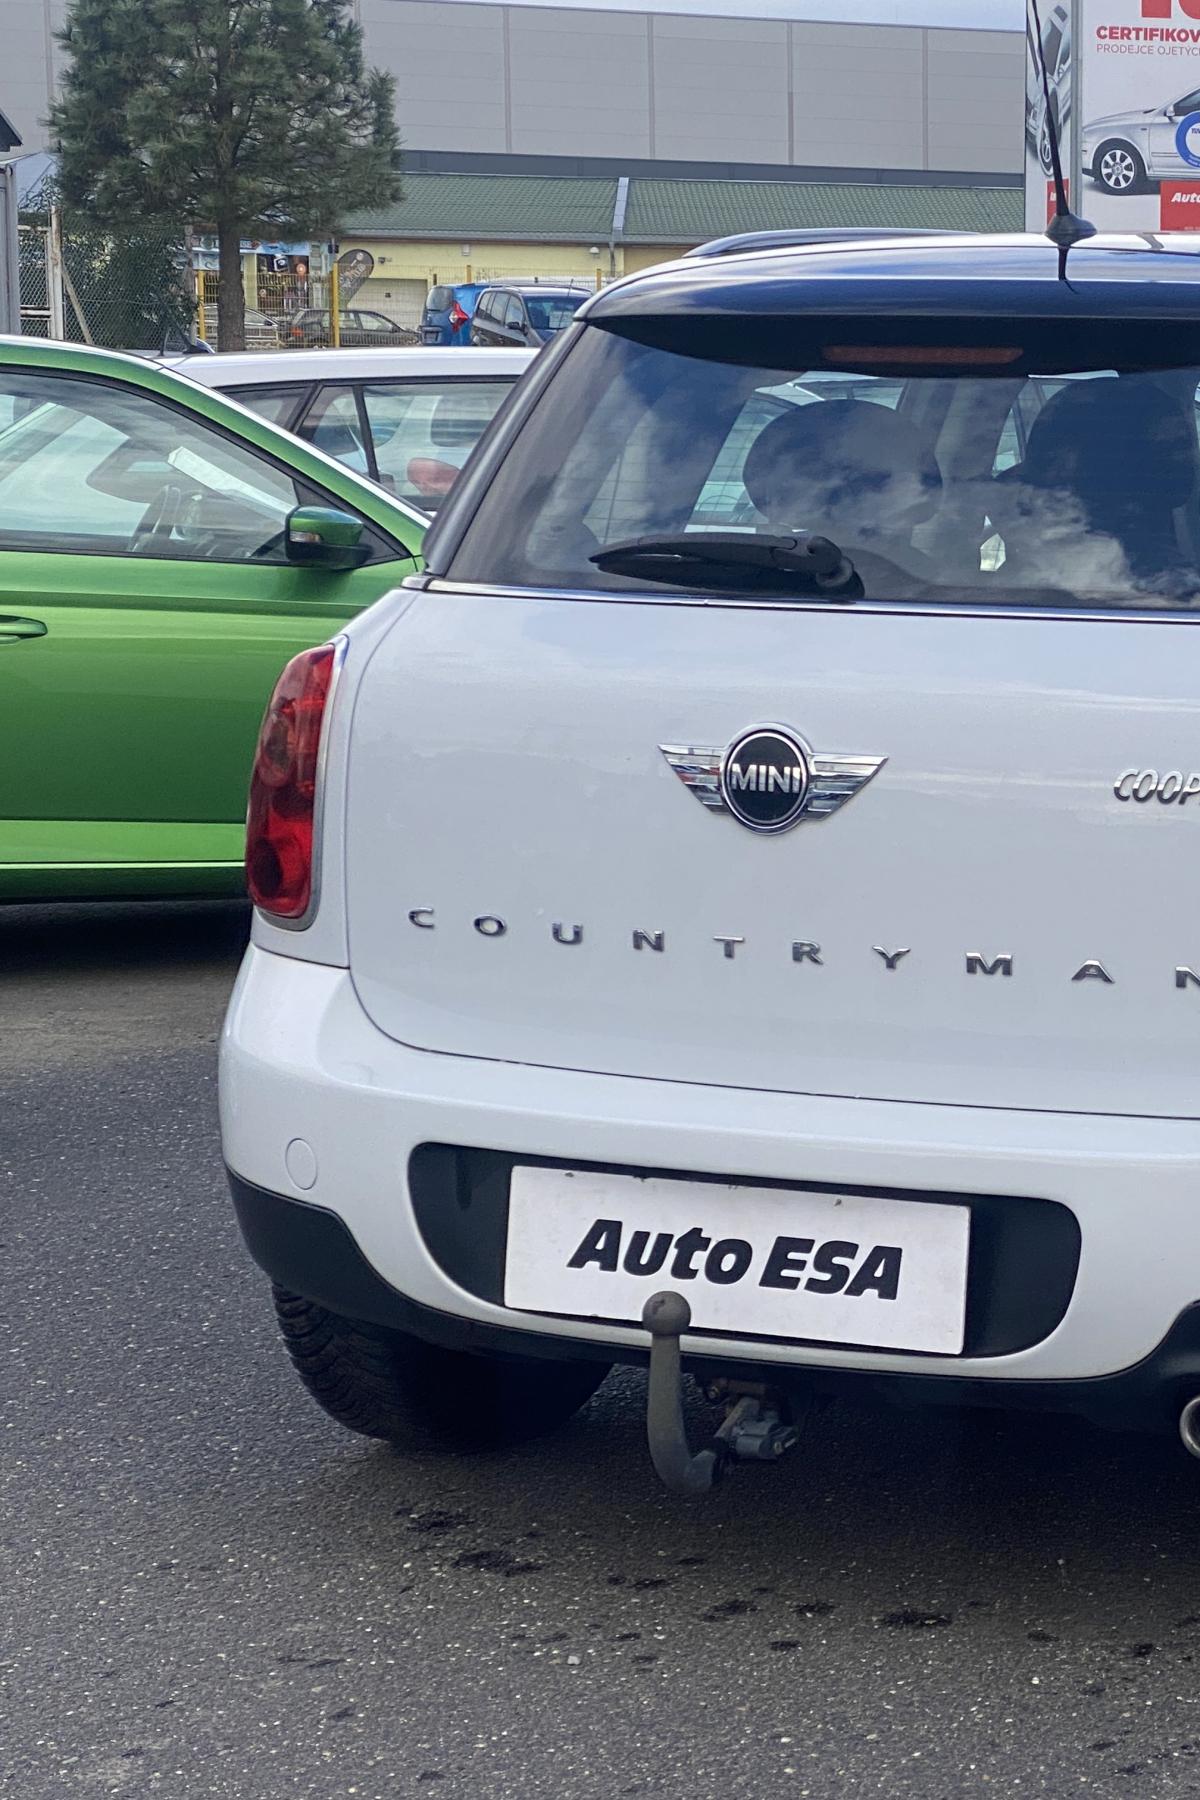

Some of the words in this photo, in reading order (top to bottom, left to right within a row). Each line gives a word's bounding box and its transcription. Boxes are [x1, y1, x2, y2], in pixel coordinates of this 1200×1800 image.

[1096, 43, 1154, 55] PRODEJCE
[730, 764, 803, 793] MINI
[566, 1218, 753, 1286] Auto
[758, 1235, 903, 1301] ESA
